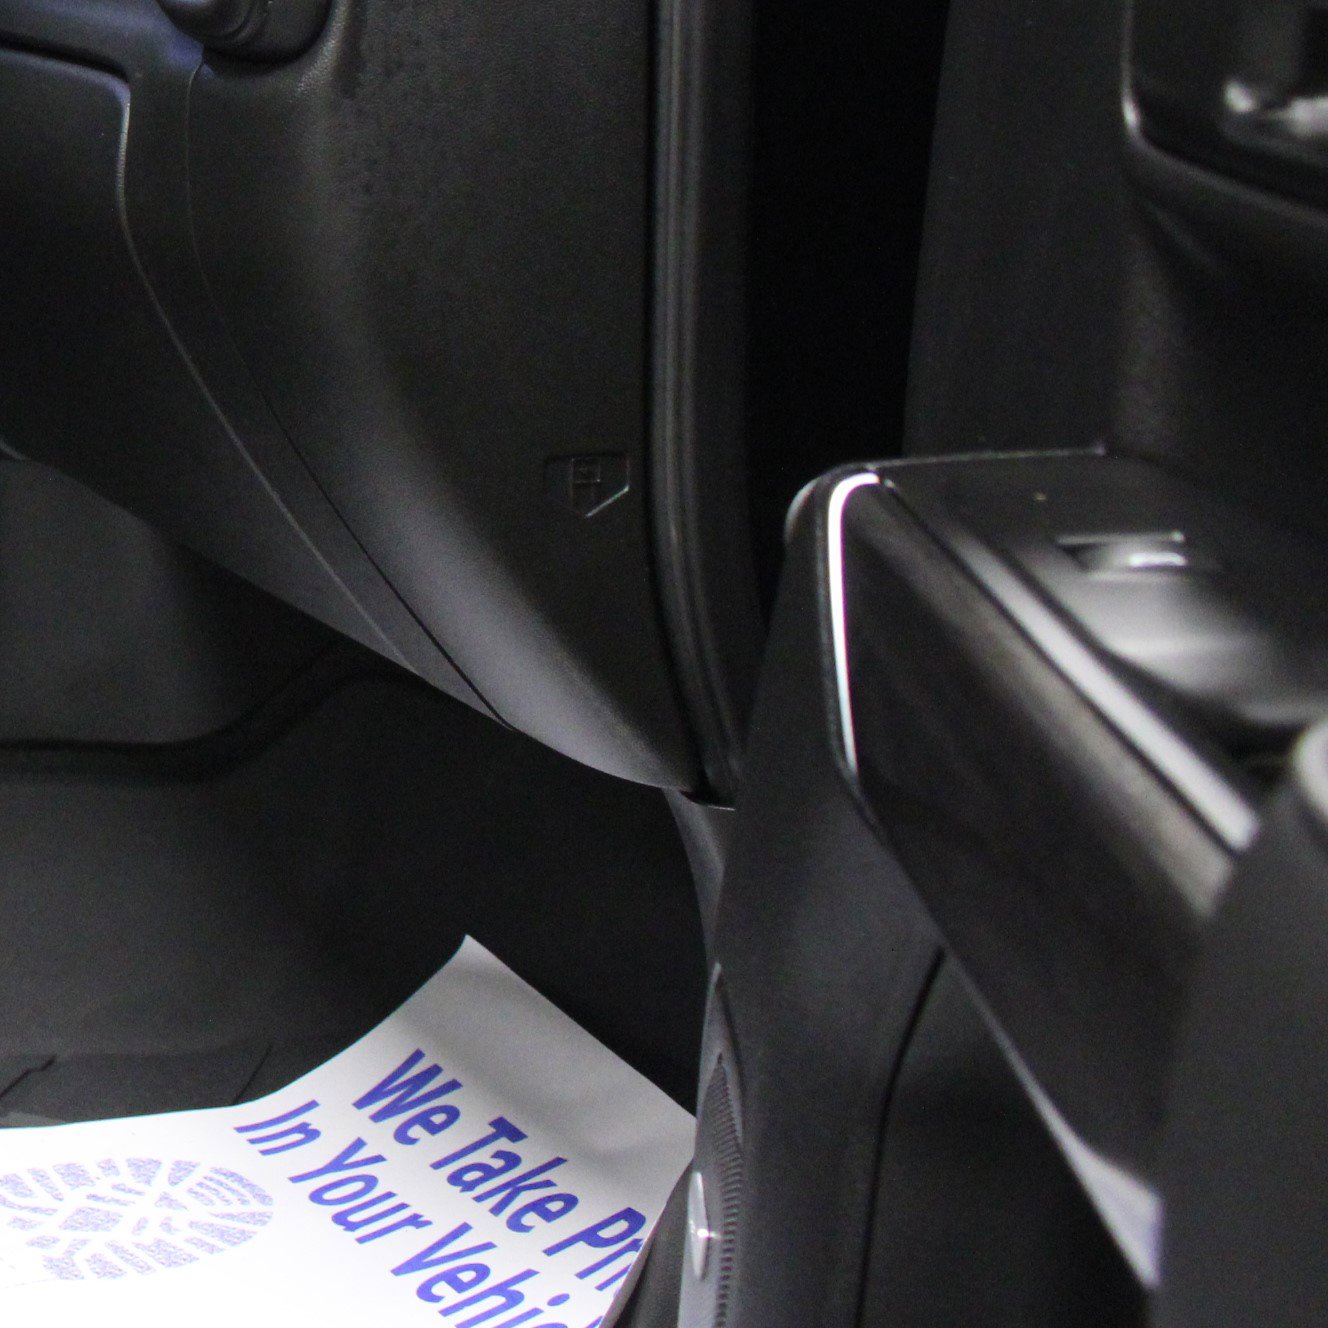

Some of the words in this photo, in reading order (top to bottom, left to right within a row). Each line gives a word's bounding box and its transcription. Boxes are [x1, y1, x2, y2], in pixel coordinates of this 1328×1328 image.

[232, 1099, 323, 1157] In
[286, 1136, 434, 1245] Your
[351, 1047, 464, 1146] We
[429, 1115, 580, 1233] Take
